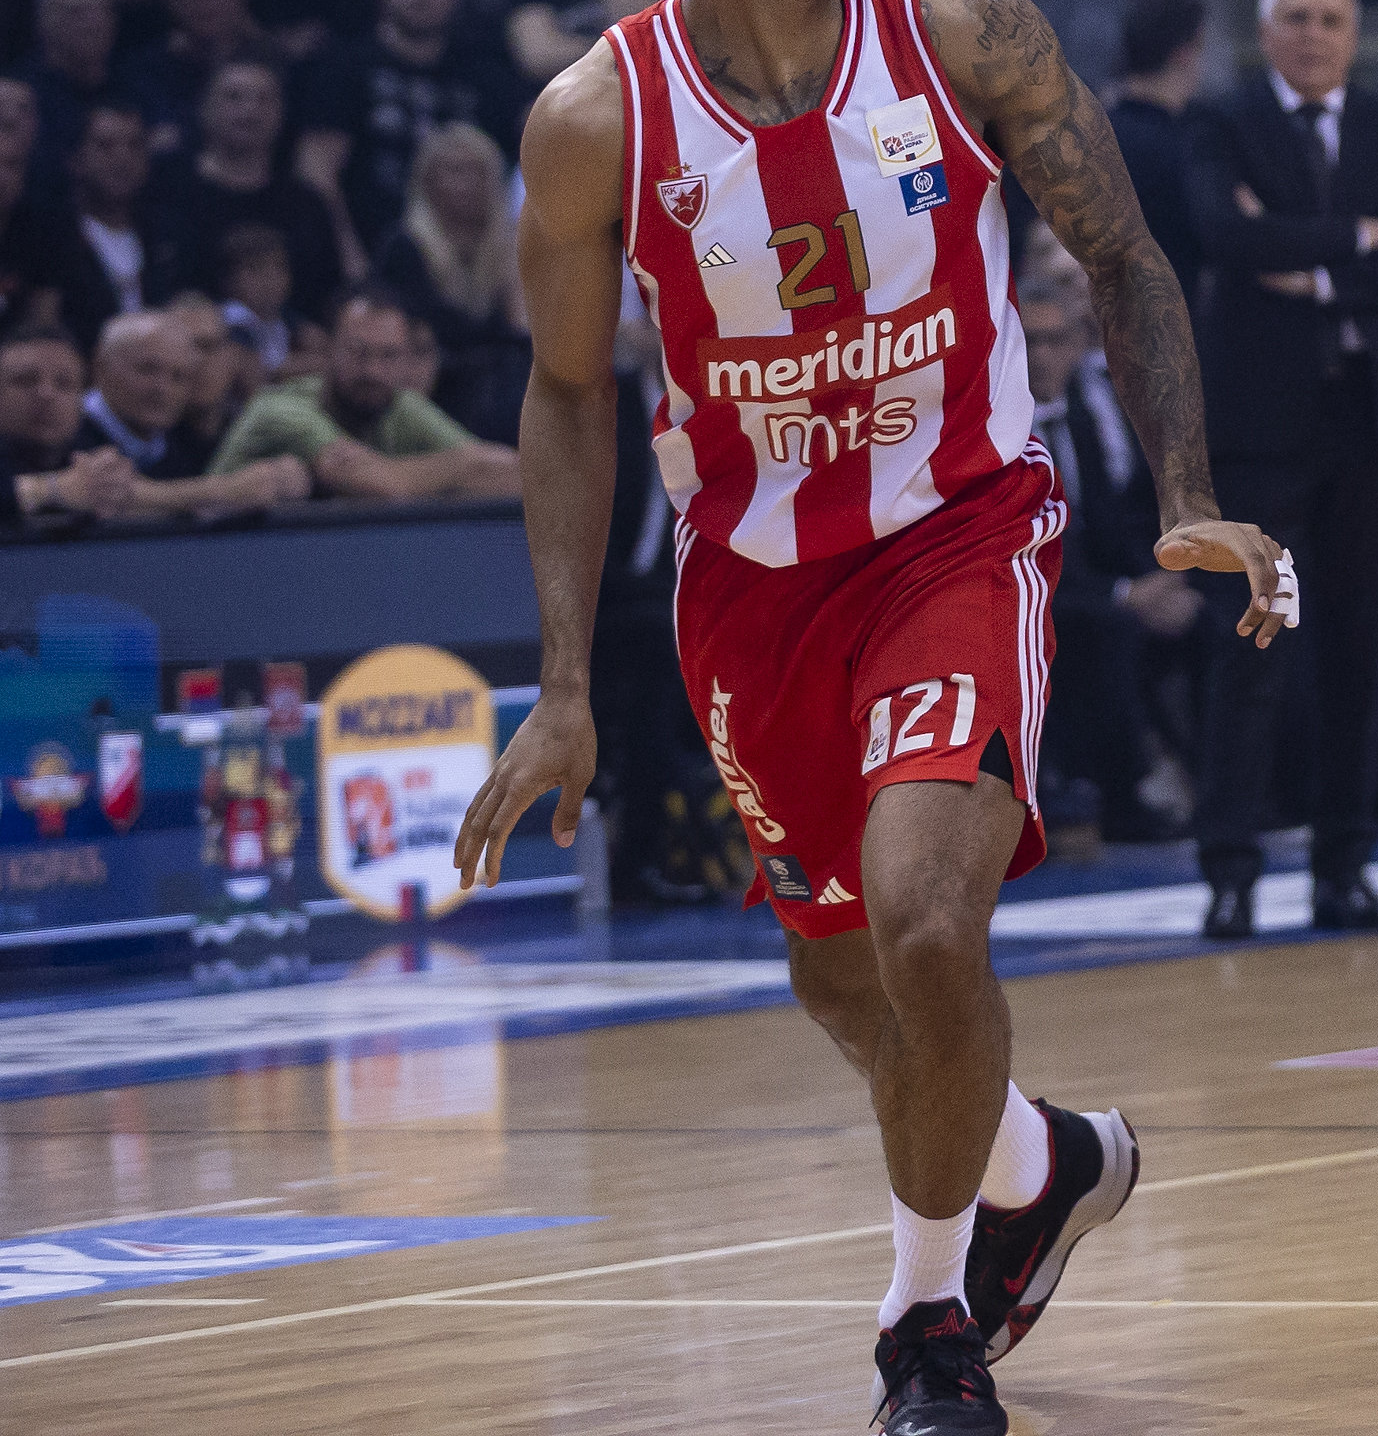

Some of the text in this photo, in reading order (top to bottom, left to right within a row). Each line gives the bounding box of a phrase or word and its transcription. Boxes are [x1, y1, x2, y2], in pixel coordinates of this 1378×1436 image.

[767, 209, 871, 311] 21
[707, 305, 957, 399] meridian
[765, 397, 917, 465] mts
